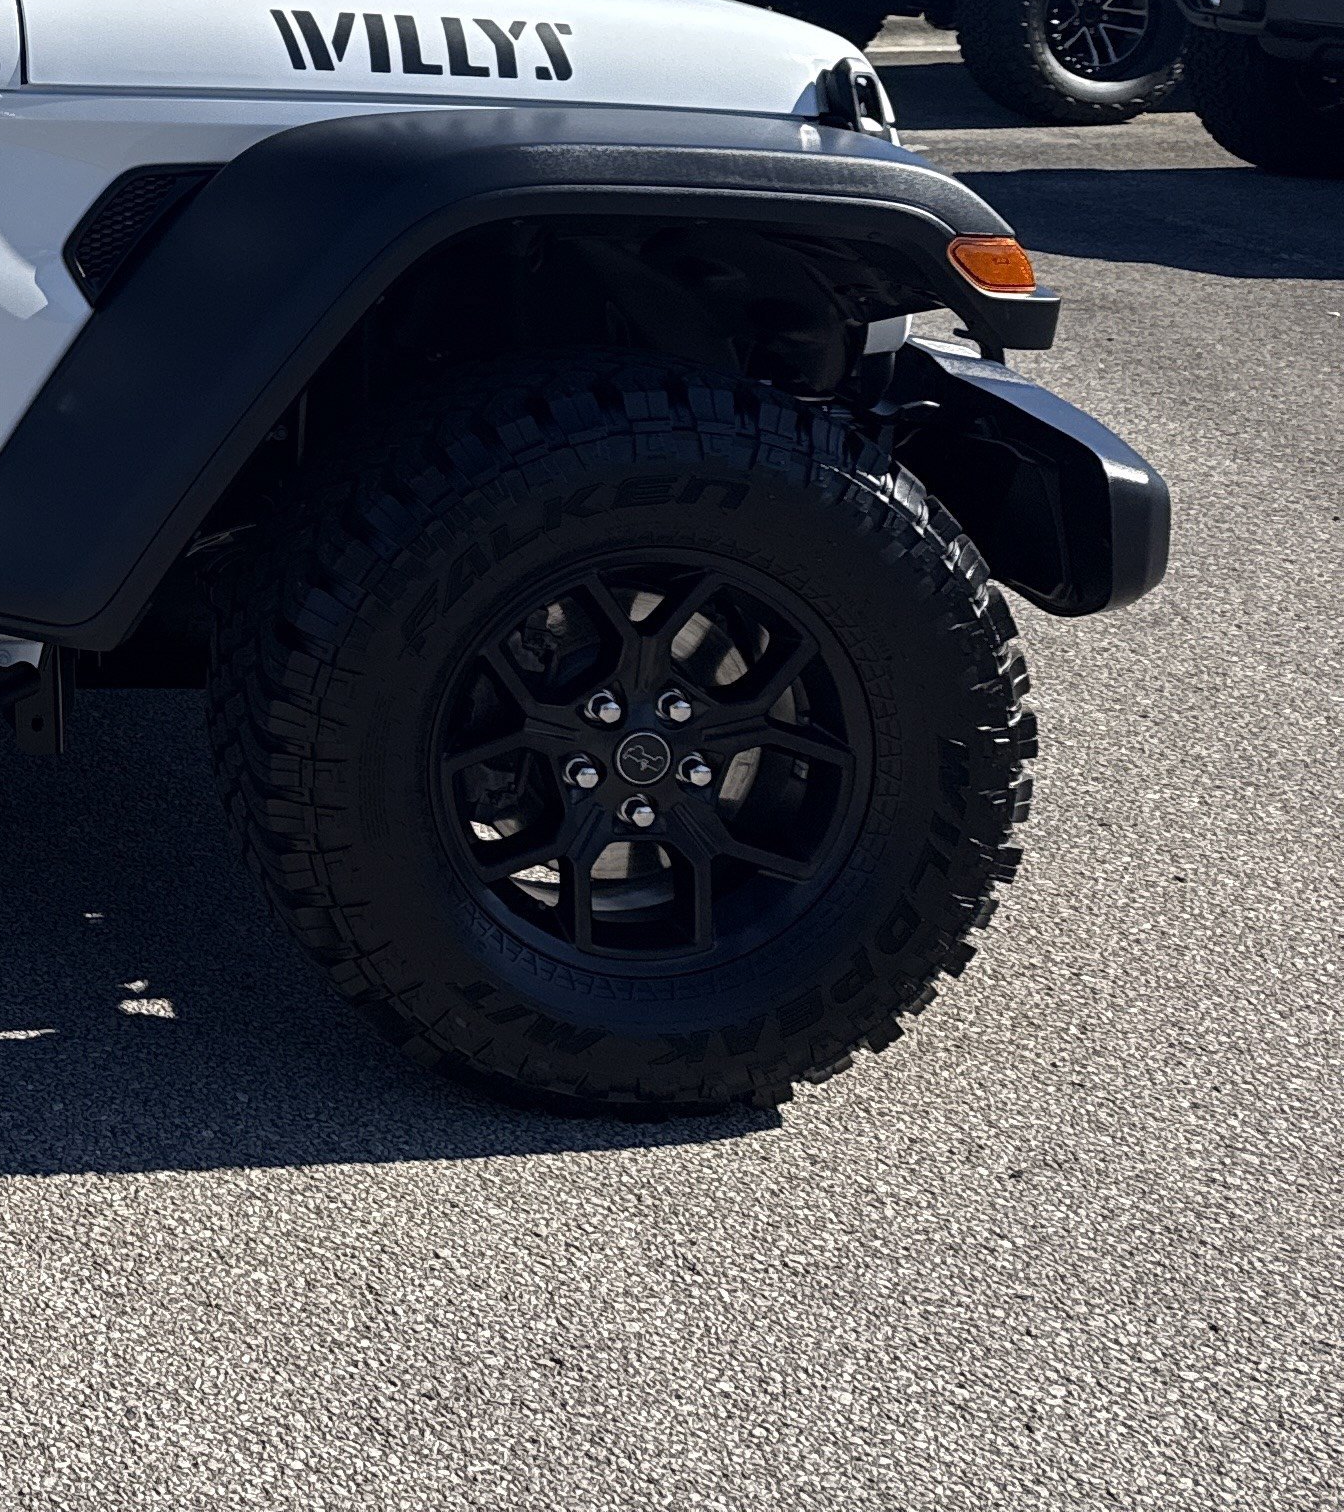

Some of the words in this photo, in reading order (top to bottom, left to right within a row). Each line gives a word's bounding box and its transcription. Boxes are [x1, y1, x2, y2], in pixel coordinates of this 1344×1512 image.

[269, 8, 573, 81] WILLYS
[399, 473, 752, 660] FALKEN
[649, 736, 969, 1068] WILDPEAK
